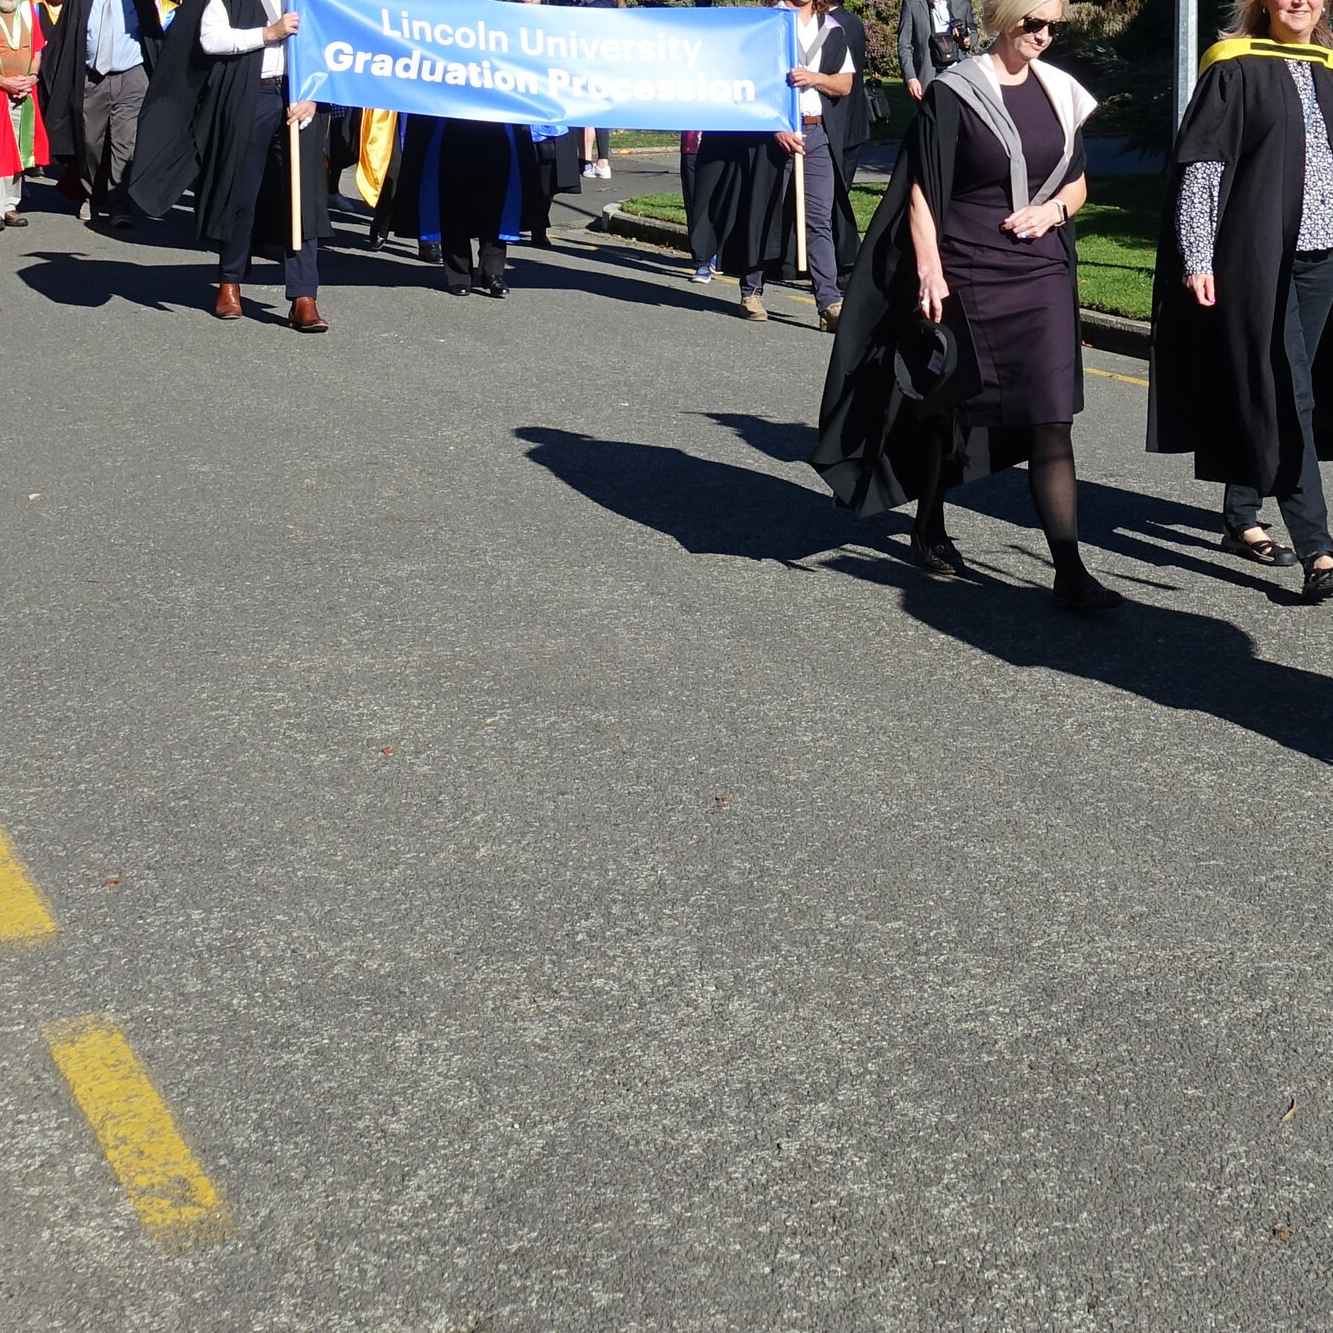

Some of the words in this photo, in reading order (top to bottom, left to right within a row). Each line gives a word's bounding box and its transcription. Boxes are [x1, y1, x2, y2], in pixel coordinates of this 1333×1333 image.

[381, 8, 509, 53] Lincoln
[519, 27, 703, 68] University
[324, 40, 540, 95] Graduation
[547, 67, 756, 103] Procession
